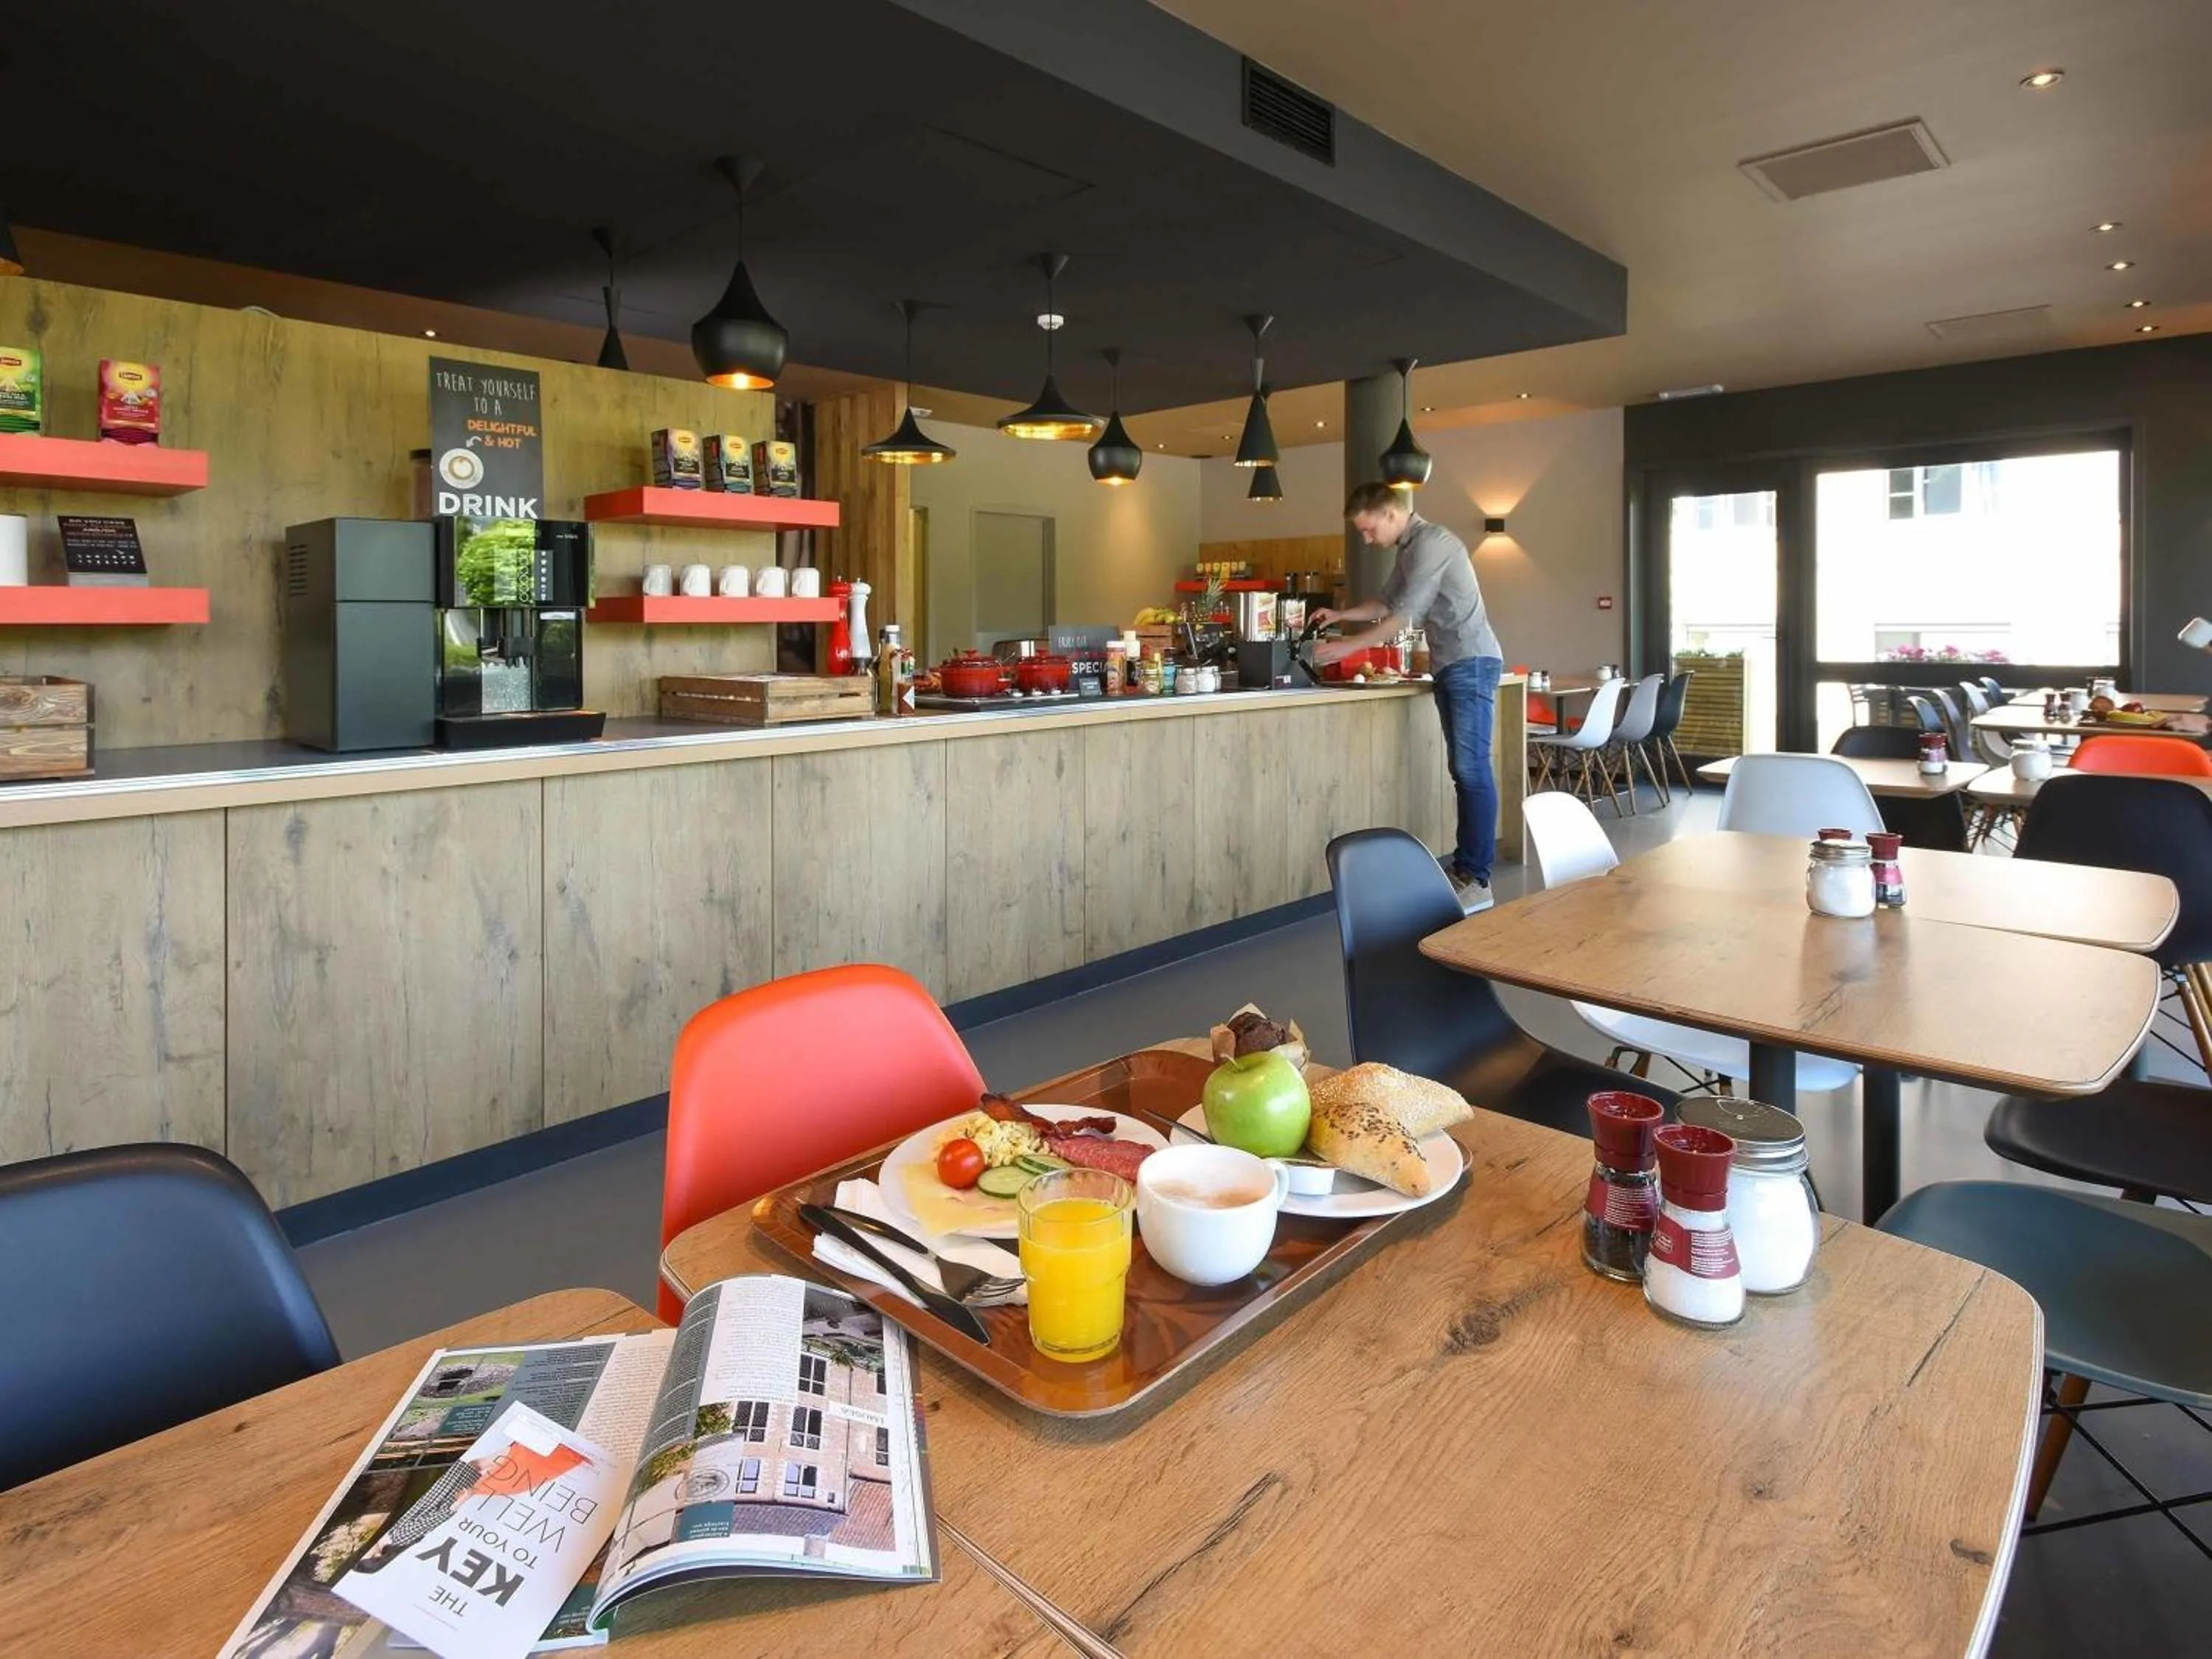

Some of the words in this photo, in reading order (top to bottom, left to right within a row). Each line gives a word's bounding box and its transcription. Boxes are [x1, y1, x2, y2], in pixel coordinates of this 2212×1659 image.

[437, 371, 473, 392] TREAT
[481, 378, 535, 400] YOURSELF
[474, 397, 487, 414] TO
[495, 399, 502, 416] A
[467, 419, 537, 437] DELIGHTFUL
[484, 435, 495, 446] &
[498, 437, 521, 448] HOT
[439, 492, 539, 519] DRINK
[487, 1455, 598, 1524] BEING
[477, 1481, 566, 1553] WELL
[458, 1517, 509, 1553] YOUR
[416, 1537, 525, 1607] KEY
[512, 1548, 539, 1570] TO
[428, 1585, 470, 1617] THE
